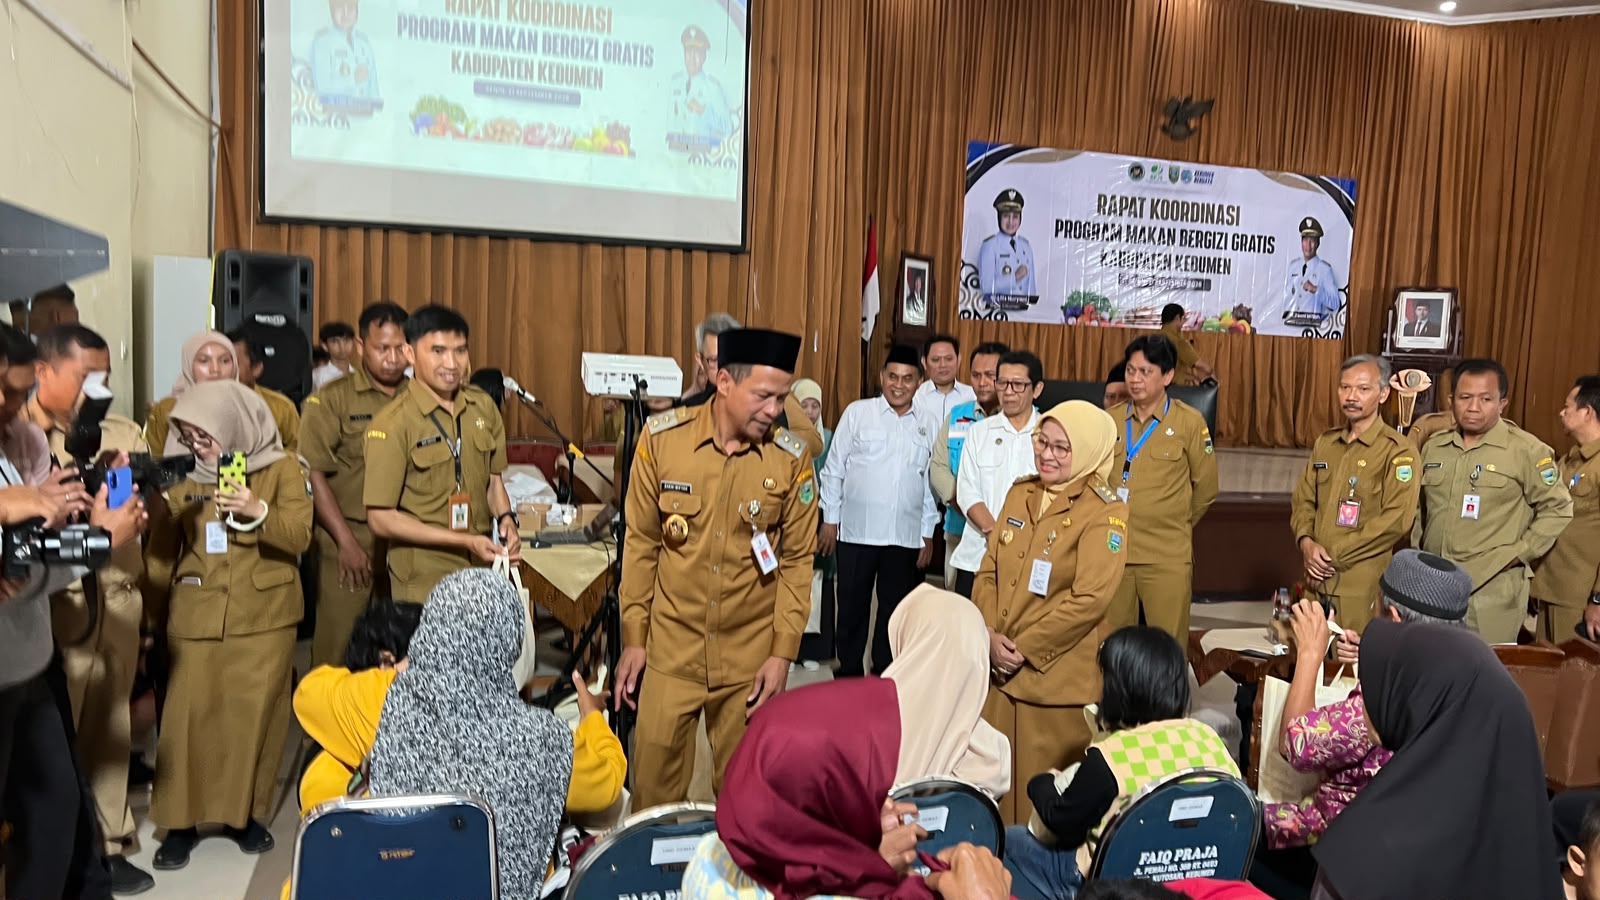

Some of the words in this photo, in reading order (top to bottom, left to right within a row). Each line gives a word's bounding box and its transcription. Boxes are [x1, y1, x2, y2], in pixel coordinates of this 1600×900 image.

[445, 0, 501, 19] RAPAT
[507, 0, 613, 34] KOORDINASI
[397, 12, 476, 46] PROGRAM
[479, 23, 538, 54] MAKAN
[541, 31, 599, 62] BERGIZI
[602, 39, 655, 68] GRATIS
[451, 50, 534, 82] KABUPATEN
[537, 60, 604, 91] KEBUMEN
[1097, 193, 1147, 218] RAPAT
[1150, 199, 1241, 227] KOORDINASI
[1054, 218, 1122, 243] PROGRAM
[1126, 224, 1176, 248] MAKAN
[1179, 229, 1228, 251] BERGIZI
[1231, 233, 1275, 254] GRATIS
[1100, 249, 1171, 271] KABUPATEN
[1175, 254, 1231, 275] KEBUMEN
[1139, 849, 1173, 865] FAIQ
[1174, 845, 1218, 861] PRAJA
[1144, 865, 1167, 875] PEMALI
